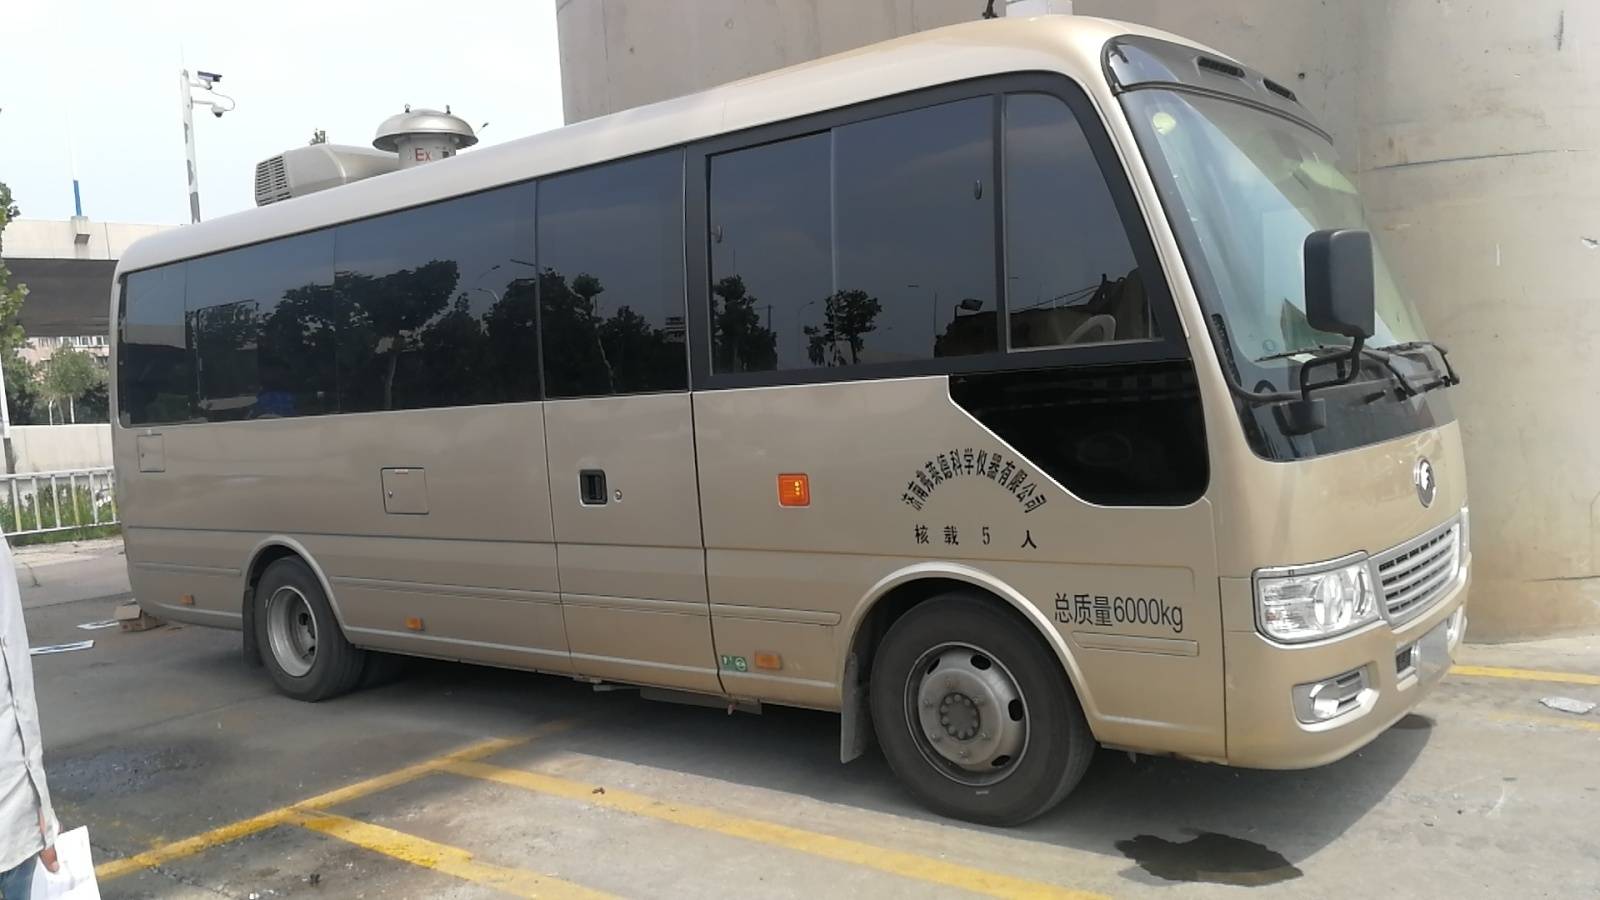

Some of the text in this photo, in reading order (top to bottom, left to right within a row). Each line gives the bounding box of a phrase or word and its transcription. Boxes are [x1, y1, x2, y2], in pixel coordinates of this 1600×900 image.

[415, 147, 432, 161] Ex
[1054, 592, 1184, 634] 总质量6000kg
